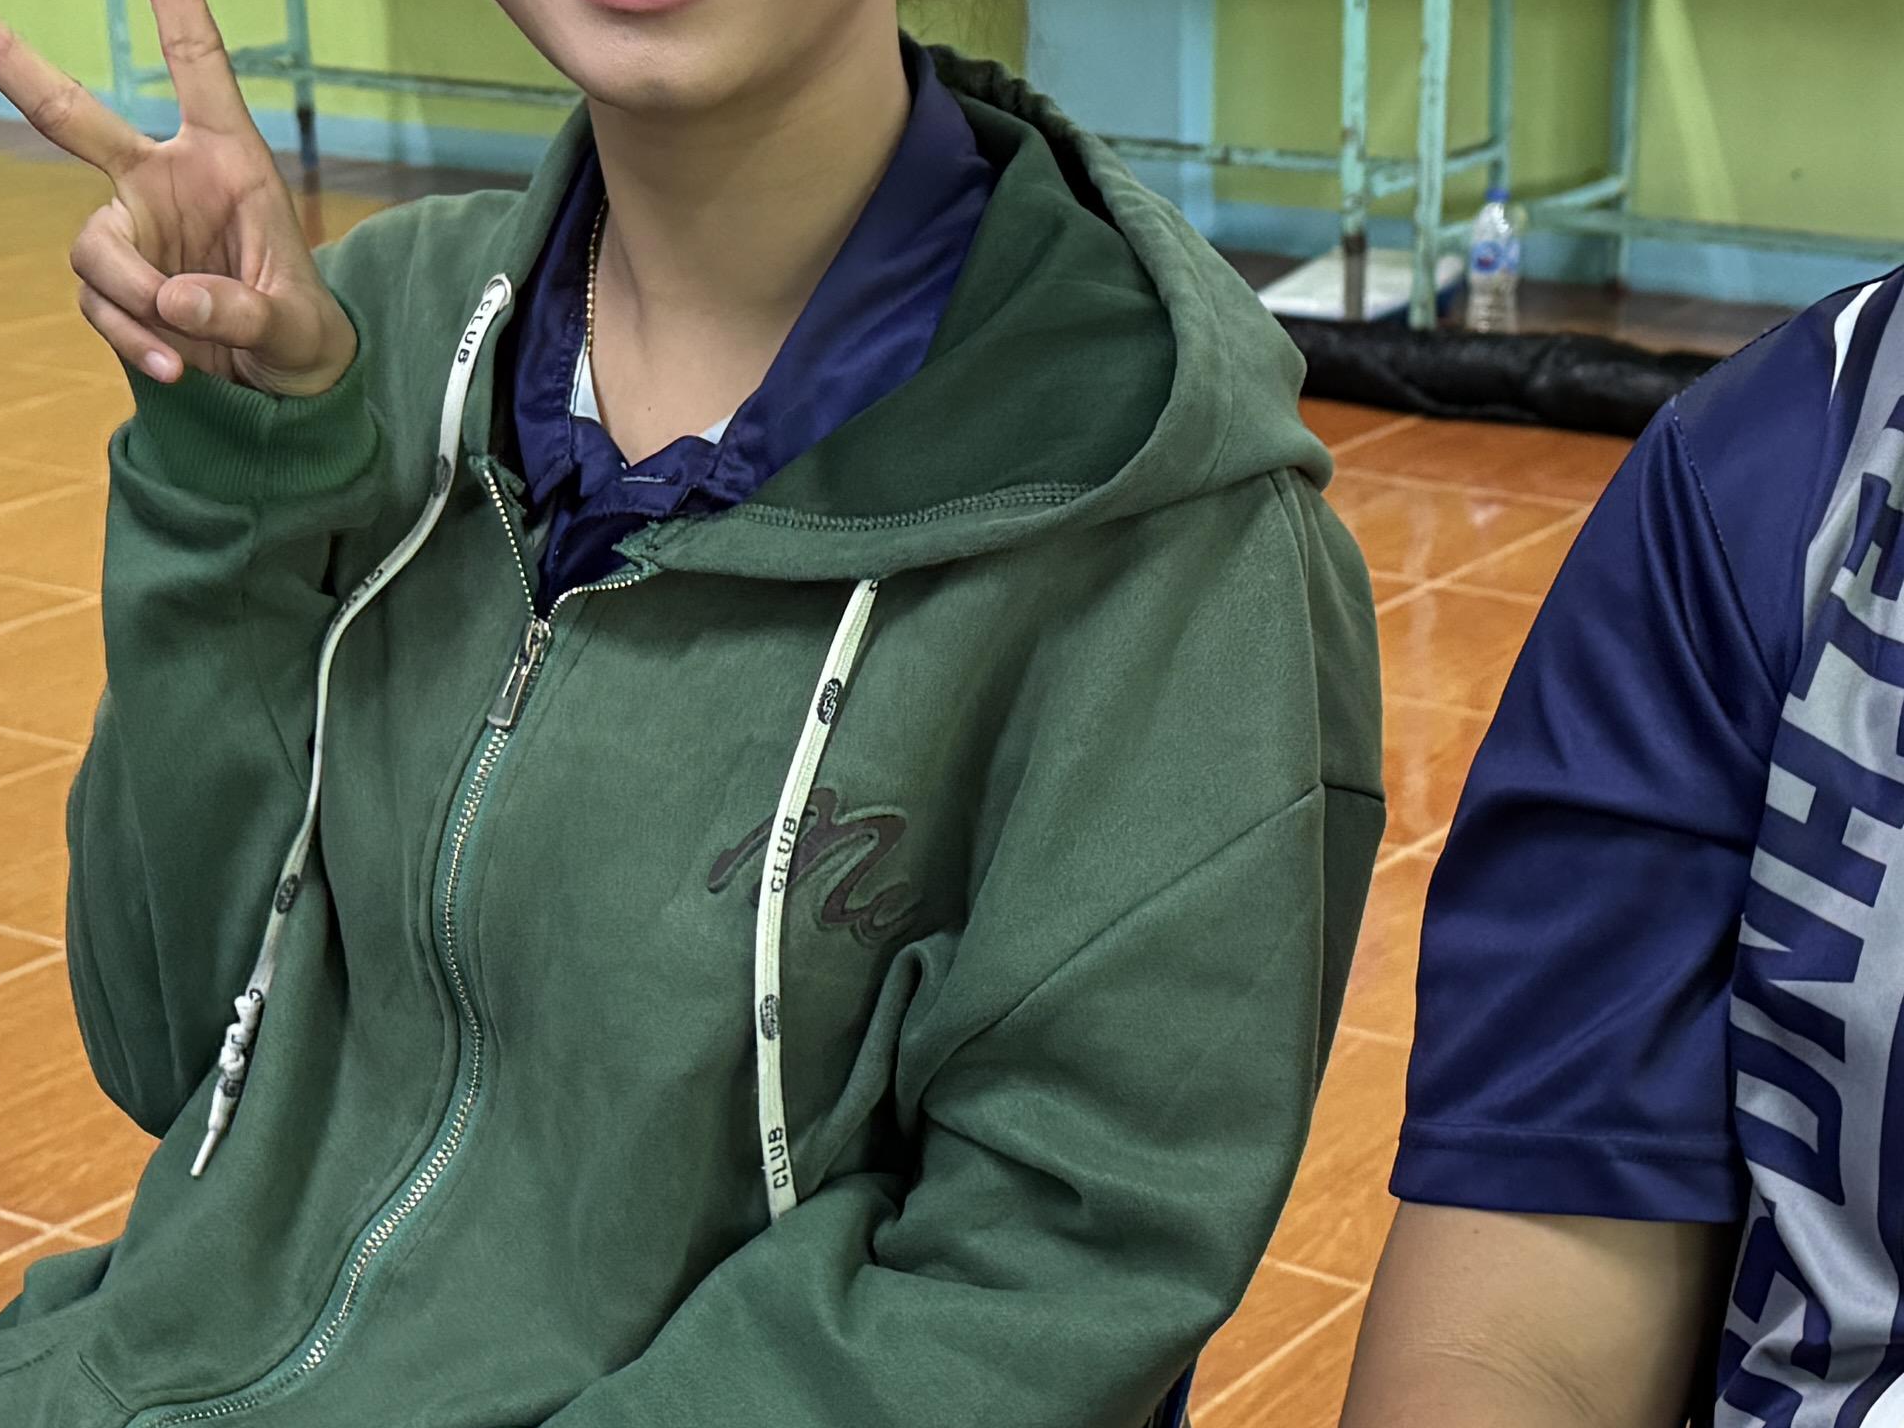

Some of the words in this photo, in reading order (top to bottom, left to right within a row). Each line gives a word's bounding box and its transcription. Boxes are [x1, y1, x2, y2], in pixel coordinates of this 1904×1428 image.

[457, 299, 492, 364] CLUB
[770, 816, 798, 894] CLUB
[767, 1125, 789, 1190] CLUB
